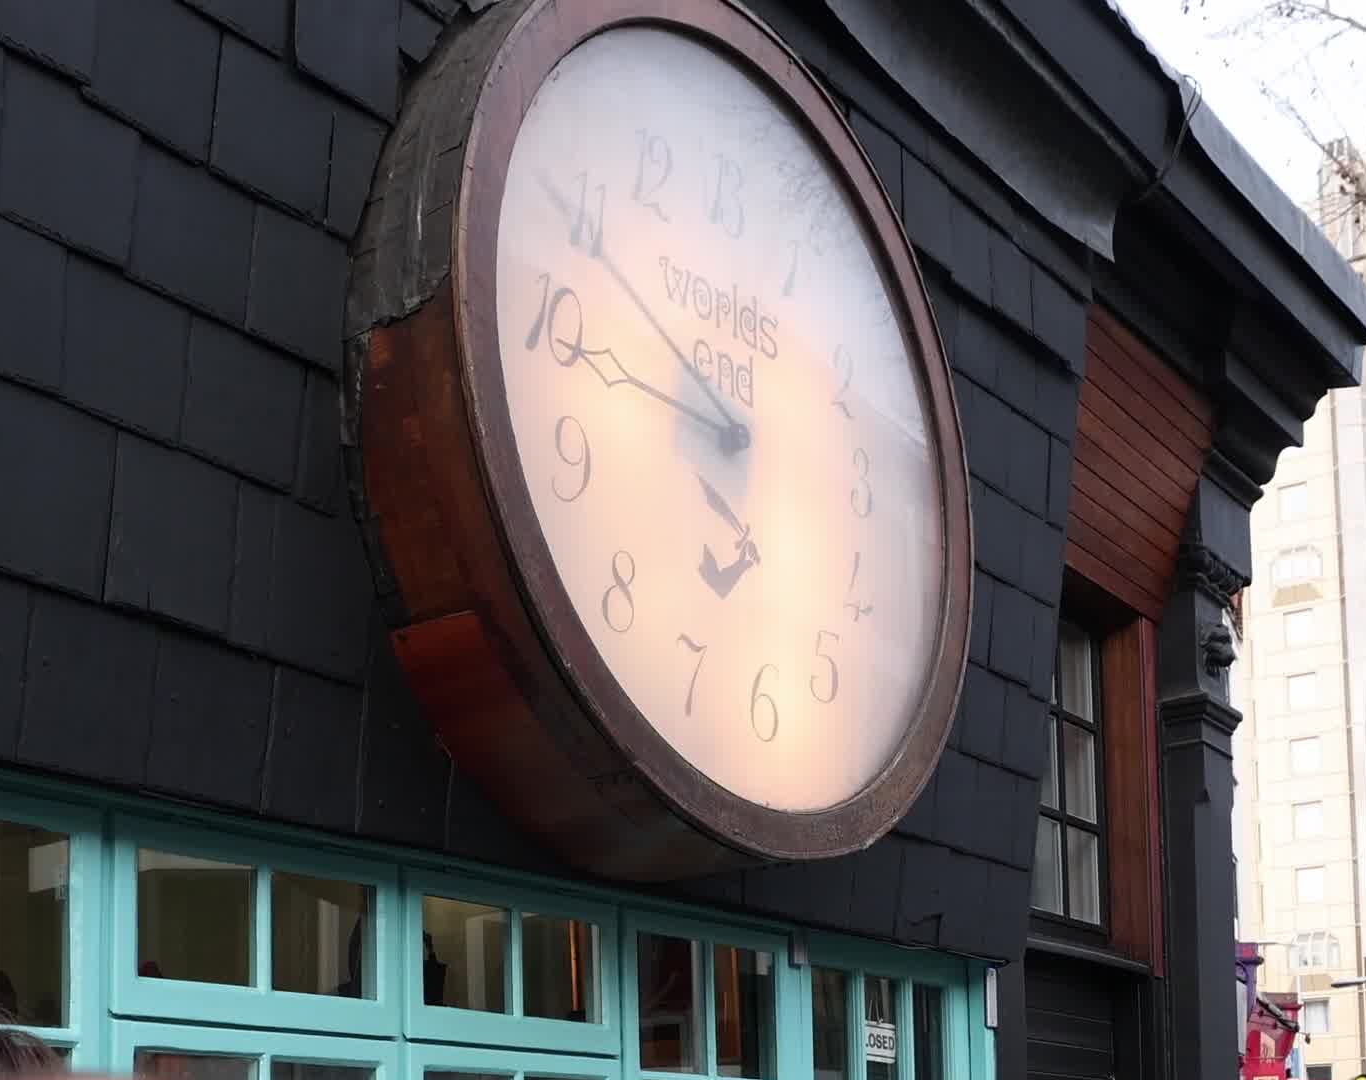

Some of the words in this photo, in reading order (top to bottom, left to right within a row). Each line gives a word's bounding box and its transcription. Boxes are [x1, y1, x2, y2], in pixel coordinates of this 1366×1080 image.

[569, 170, 606, 258] 11
[633, 127, 673, 224] 12
[525, 272, 583, 367] 10
[693, 339, 754, 409] end
[551, 415, 592, 502] 9
[850, 448, 873, 519] 3
[601, 550, 635, 633] 8
[676, 632, 708, 717] 7
[750, 663, 780, 743] 6
[810, 629, 841, 704] 5
[866, 1033, 895, 1051] OSED
